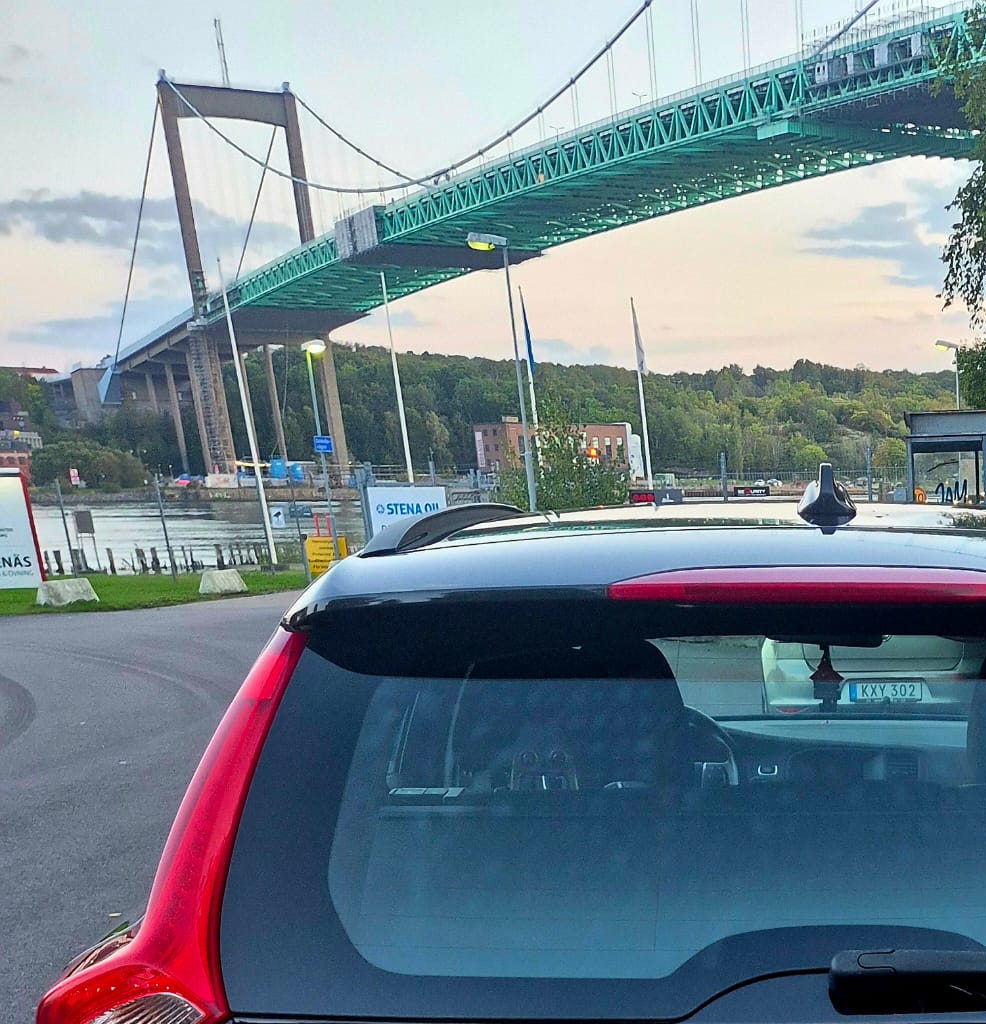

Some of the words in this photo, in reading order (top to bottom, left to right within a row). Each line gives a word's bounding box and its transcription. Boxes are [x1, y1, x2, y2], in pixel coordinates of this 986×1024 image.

[386, 502, 423, 515] STENA
[0, 553, 32, 568] NÄS
[861, 684, 886, 697] KXY
[891, 684, 916, 697] 302
